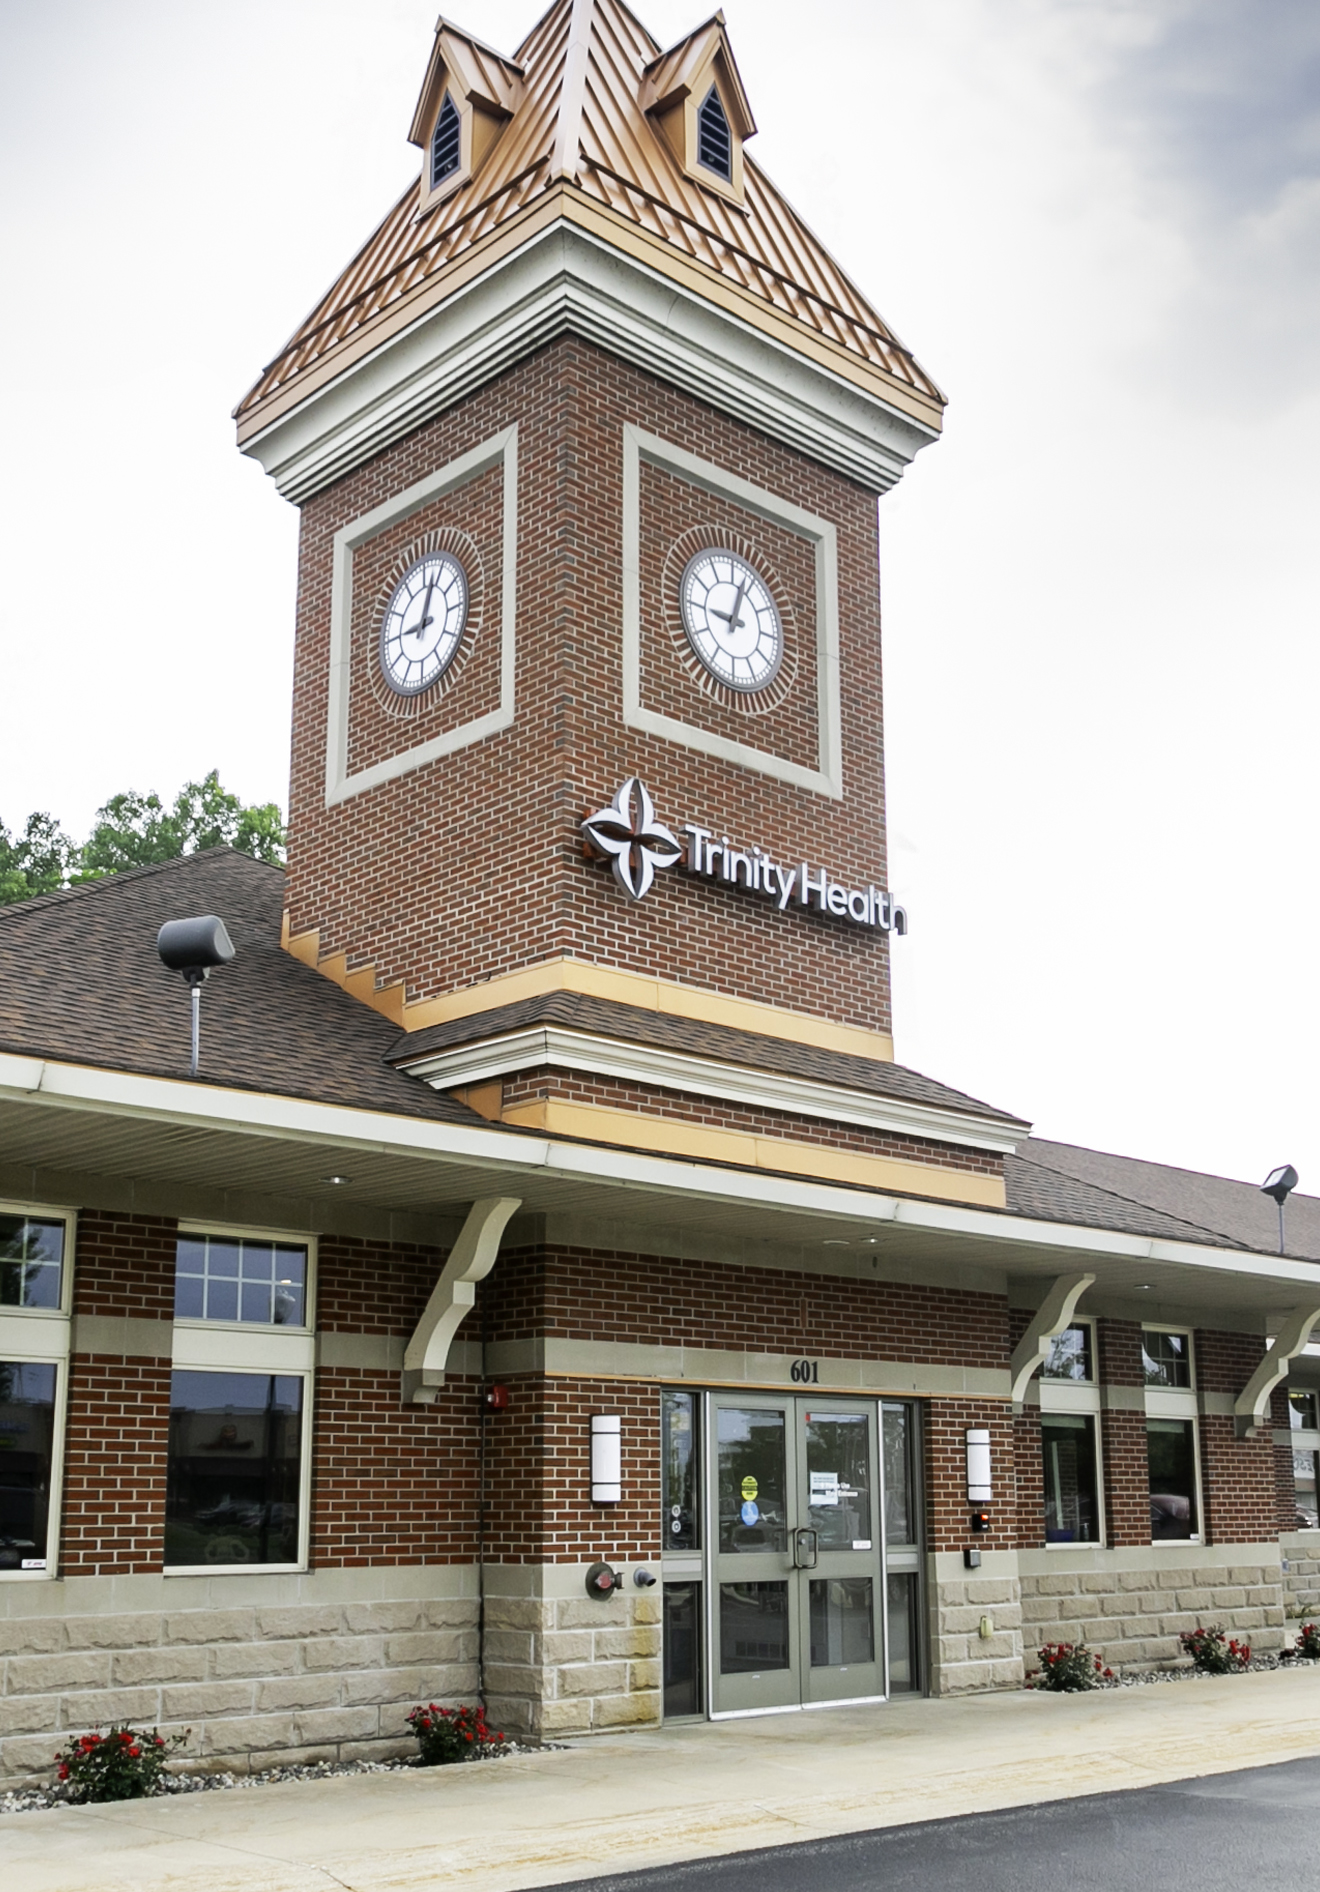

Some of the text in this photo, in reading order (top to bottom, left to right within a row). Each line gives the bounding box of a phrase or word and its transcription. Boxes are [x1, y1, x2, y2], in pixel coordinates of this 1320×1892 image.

[680, 824, 908, 935] Trinity Health
[790, 1359, 819, 1384] 601
